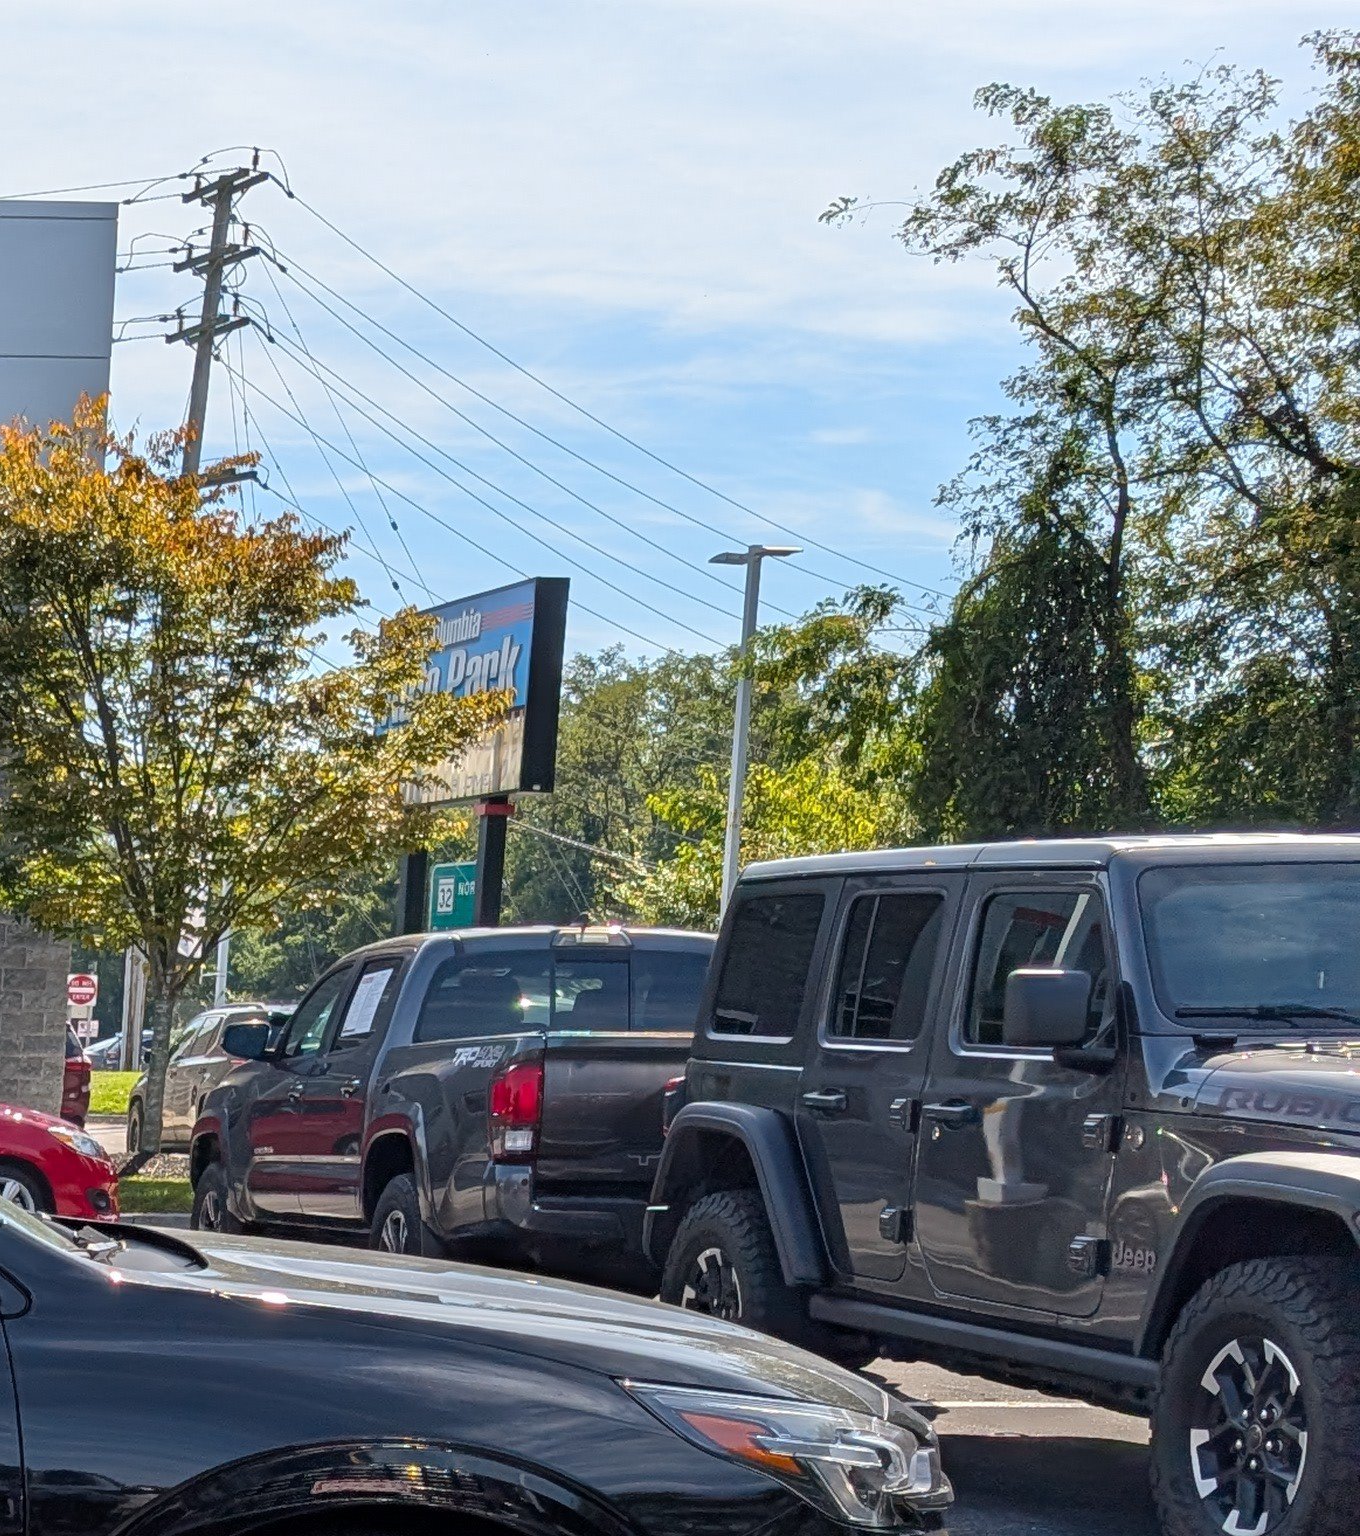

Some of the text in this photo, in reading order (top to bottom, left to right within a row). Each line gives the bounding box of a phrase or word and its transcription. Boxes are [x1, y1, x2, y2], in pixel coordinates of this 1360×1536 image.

[431, 608, 482, 646] olumbia
[447, 634, 521, 695] Park
[439, 887, 453, 909] 32
[1111, 1240, 1157, 1273] Jeep
